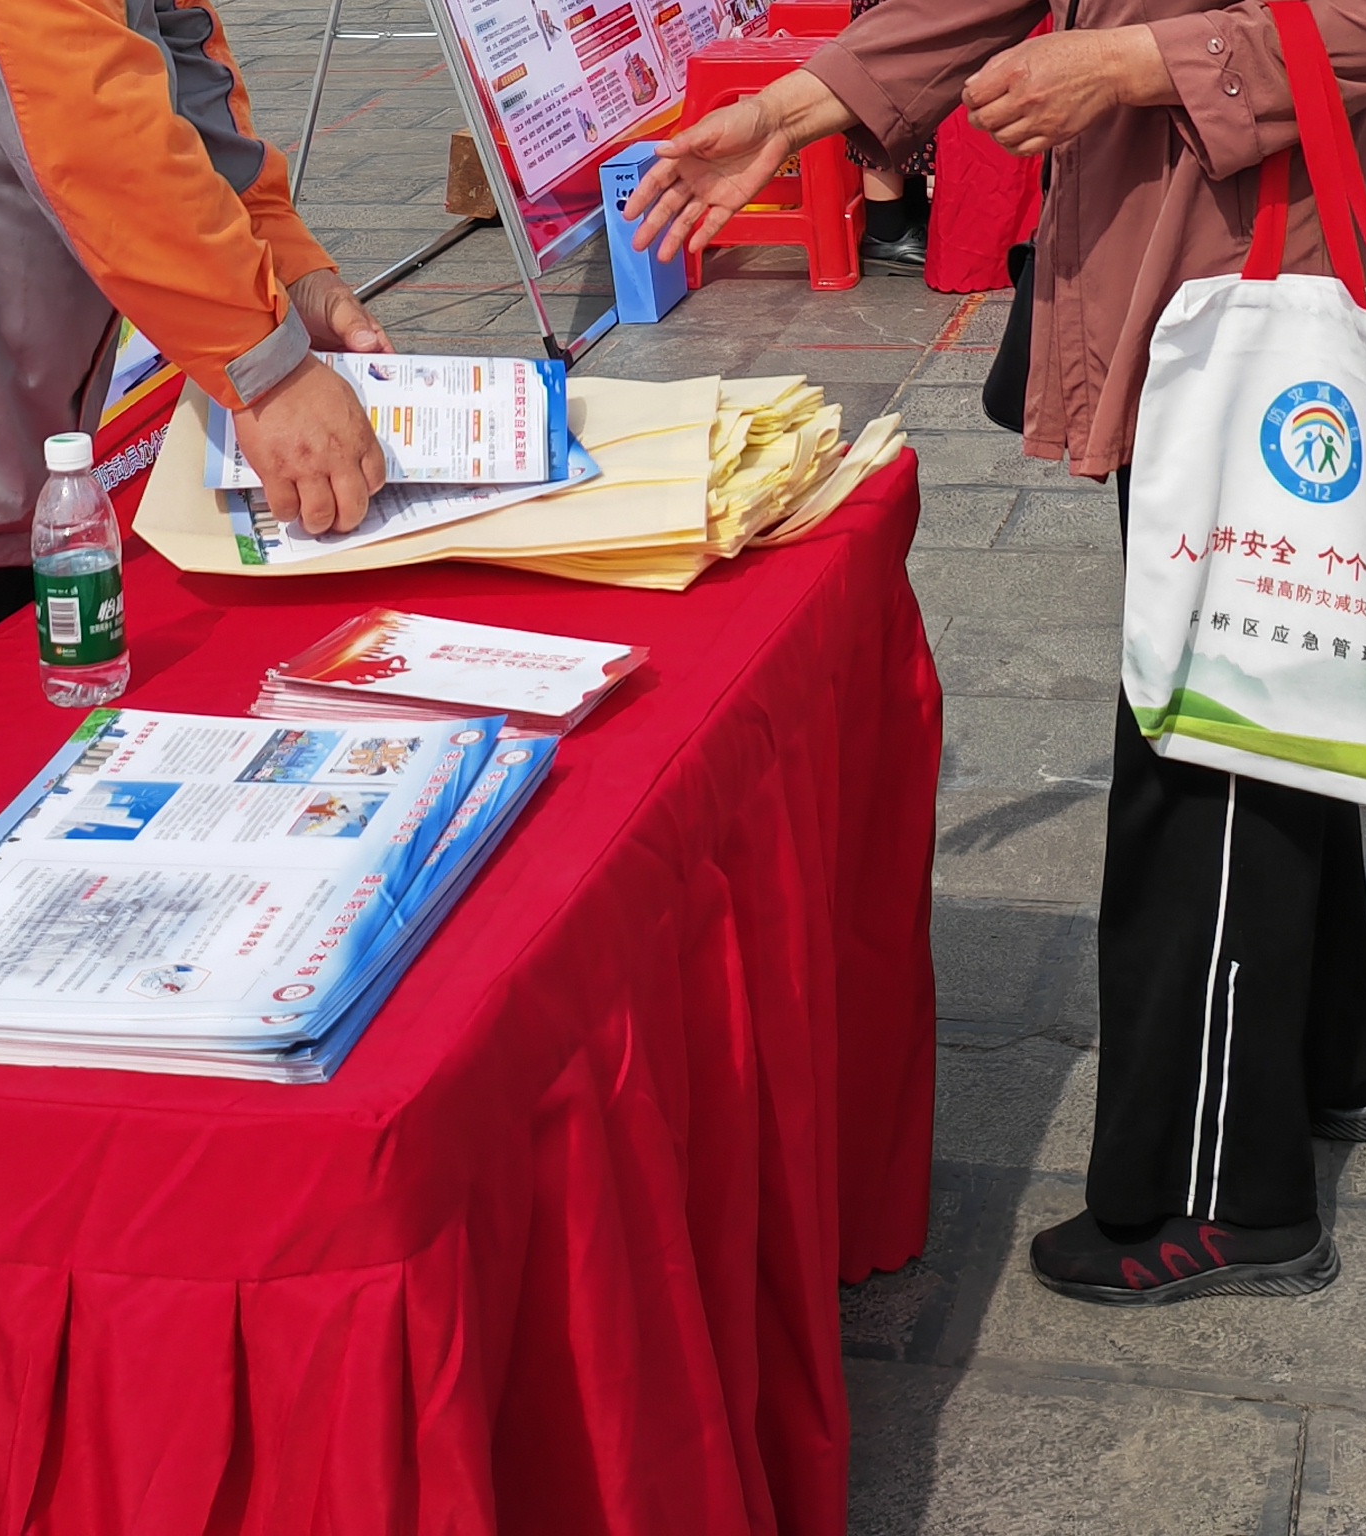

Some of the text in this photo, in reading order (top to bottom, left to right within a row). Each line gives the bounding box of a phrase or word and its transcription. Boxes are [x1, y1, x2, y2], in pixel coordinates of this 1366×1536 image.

[1267, 382, 1362, 442] 防灾减灾日
[90, 422, 170, 493] 防动员办公
